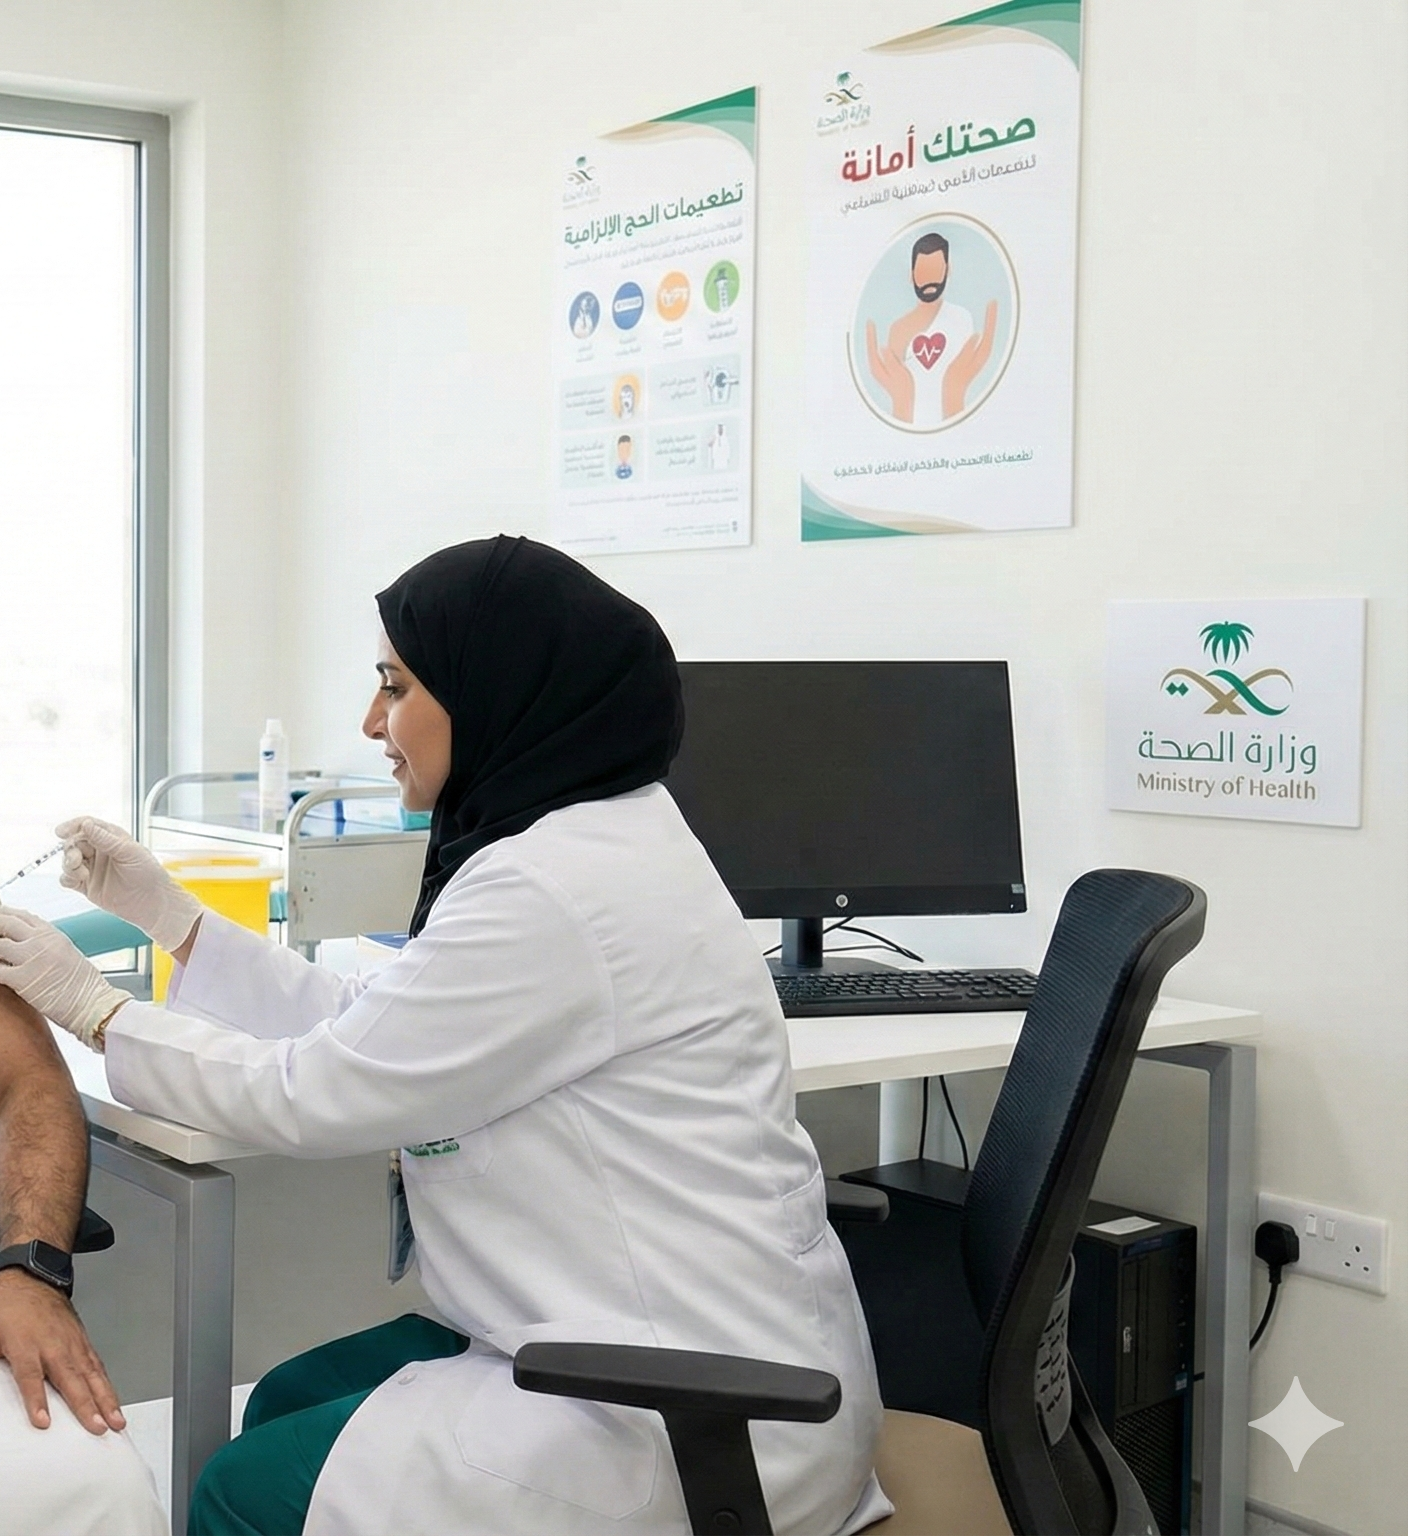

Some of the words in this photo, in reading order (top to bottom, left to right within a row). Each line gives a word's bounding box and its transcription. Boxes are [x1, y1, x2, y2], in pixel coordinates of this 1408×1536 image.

[841, 124, 915, 183] أمانة
[923, 116, 1036, 164] صحتك
[624, 203, 660, 238] الحج
[663, 182, 744, 221] تطعيمات
[564, 213, 622, 250] الإلزامية
[1138, 730, 1234, 763] الصحة
[1244, 733, 1317, 775] وزارة
[1137, 772, 1216, 798] Ministry
[1221, 776, 1245, 795] of
[1249, 779, 1317, 800] Health
